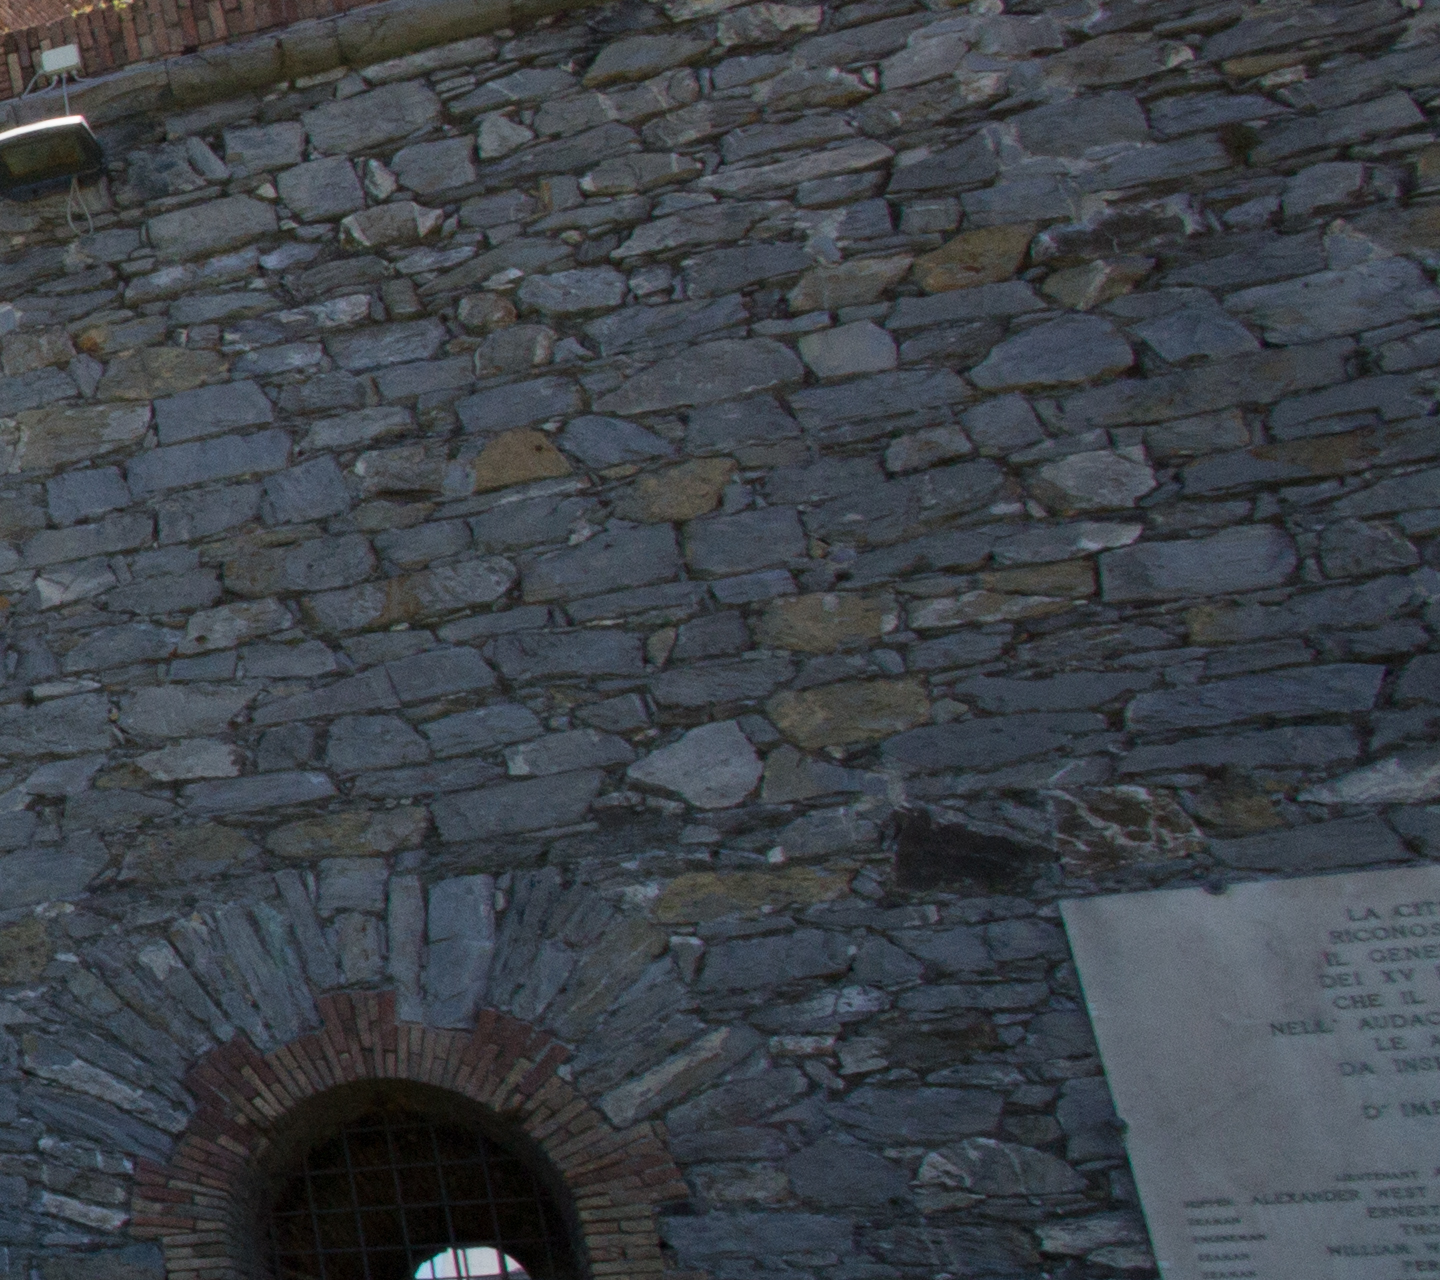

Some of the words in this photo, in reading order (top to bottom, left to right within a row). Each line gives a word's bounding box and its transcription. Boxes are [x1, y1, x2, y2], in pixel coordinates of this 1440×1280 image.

[1346, 906, 1382, 921] LA
[1391, 900, 1440, 918] CIT
[1323, 951, 1350, 967] IL
[1318, 971, 1364, 988] DEI
[1380, 968, 1415, 984] XV
[1333, 993, 1384, 1010] CHE
[1399, 990, 1427, 1005] IL
[1269, 1018, 1339, 1036] NELL'
[1358, 1011, 1440, 1030] AUDAC
[1374, 1036, 1407, 1052] LE
[1338, 1061, 1377, 1077] DA
[1362, 1102, 1389, 1120] D'
[1252, 1189, 1362, 1206] ALEXANDER
[1374, 1186, 1427, 1199] WEST
